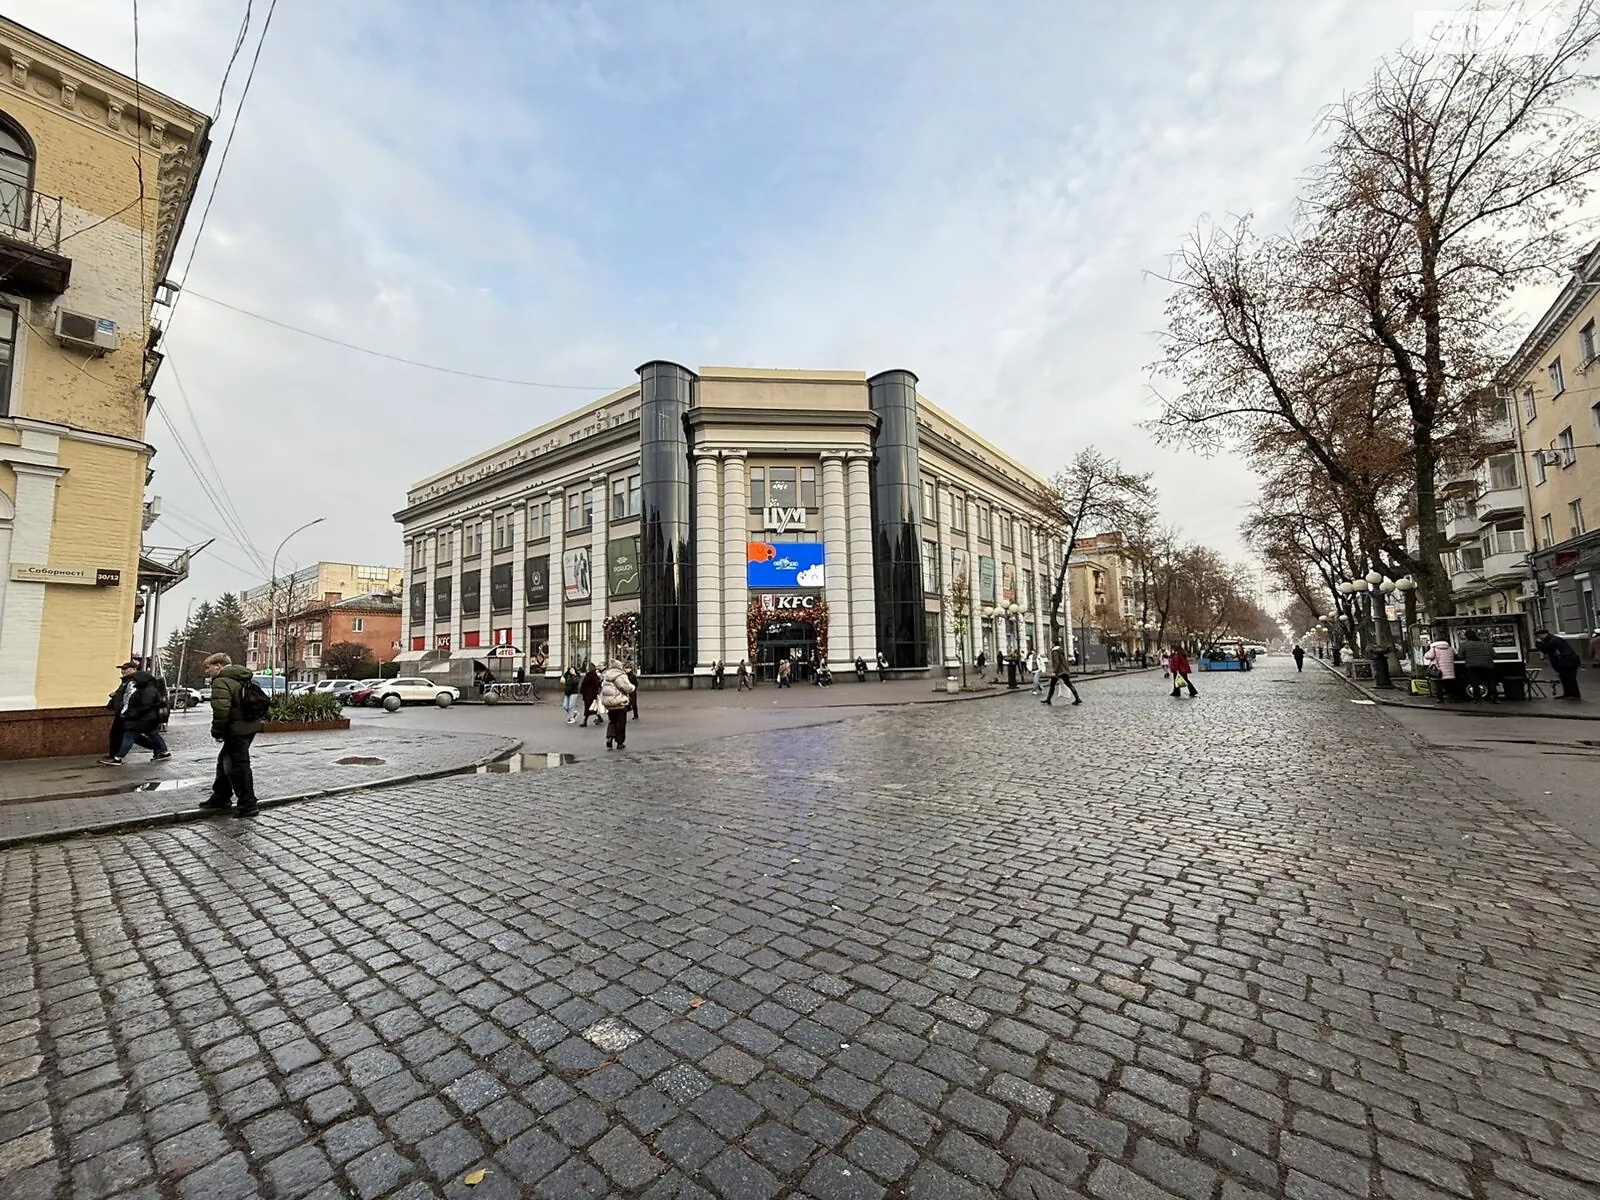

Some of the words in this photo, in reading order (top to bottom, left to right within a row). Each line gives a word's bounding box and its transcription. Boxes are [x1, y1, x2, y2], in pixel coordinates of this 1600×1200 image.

[763, 507, 806, 533] ЦУМ
[28, 567, 84, 576] Соборності
[777, 596, 814, 609] KFC
